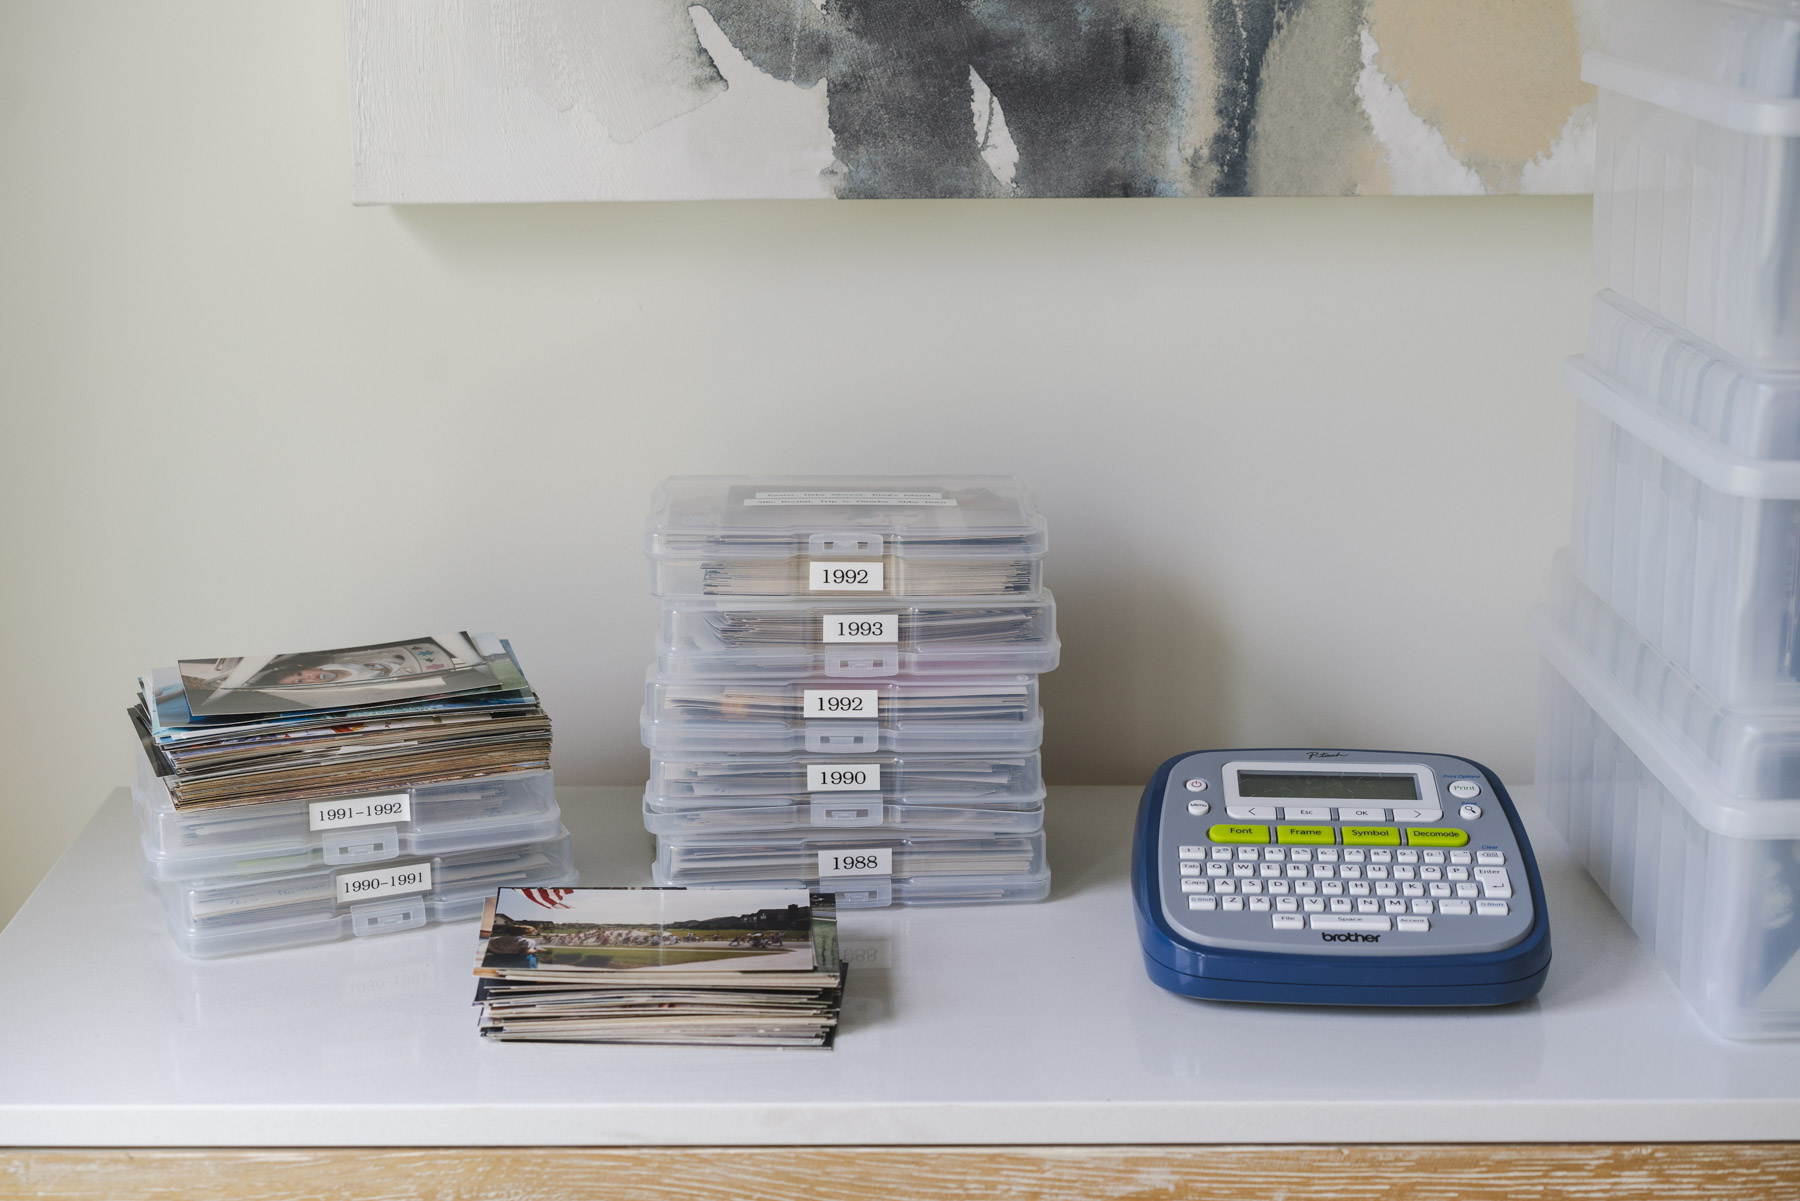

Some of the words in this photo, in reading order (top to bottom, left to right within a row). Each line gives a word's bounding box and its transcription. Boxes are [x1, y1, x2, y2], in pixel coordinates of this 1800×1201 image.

[821, 569, 869, 584] 1992
[837, 621, 884, 637] 1993
[816, 696, 864, 712] 1992
[819, 771, 867, 785] 1990
[1290, 828, 1322, 836] Frame
[1351, 829, 1389, 837] Symbol
[832, 855, 879, 870] 1988
[1321, 932, 1381, 943] brother
